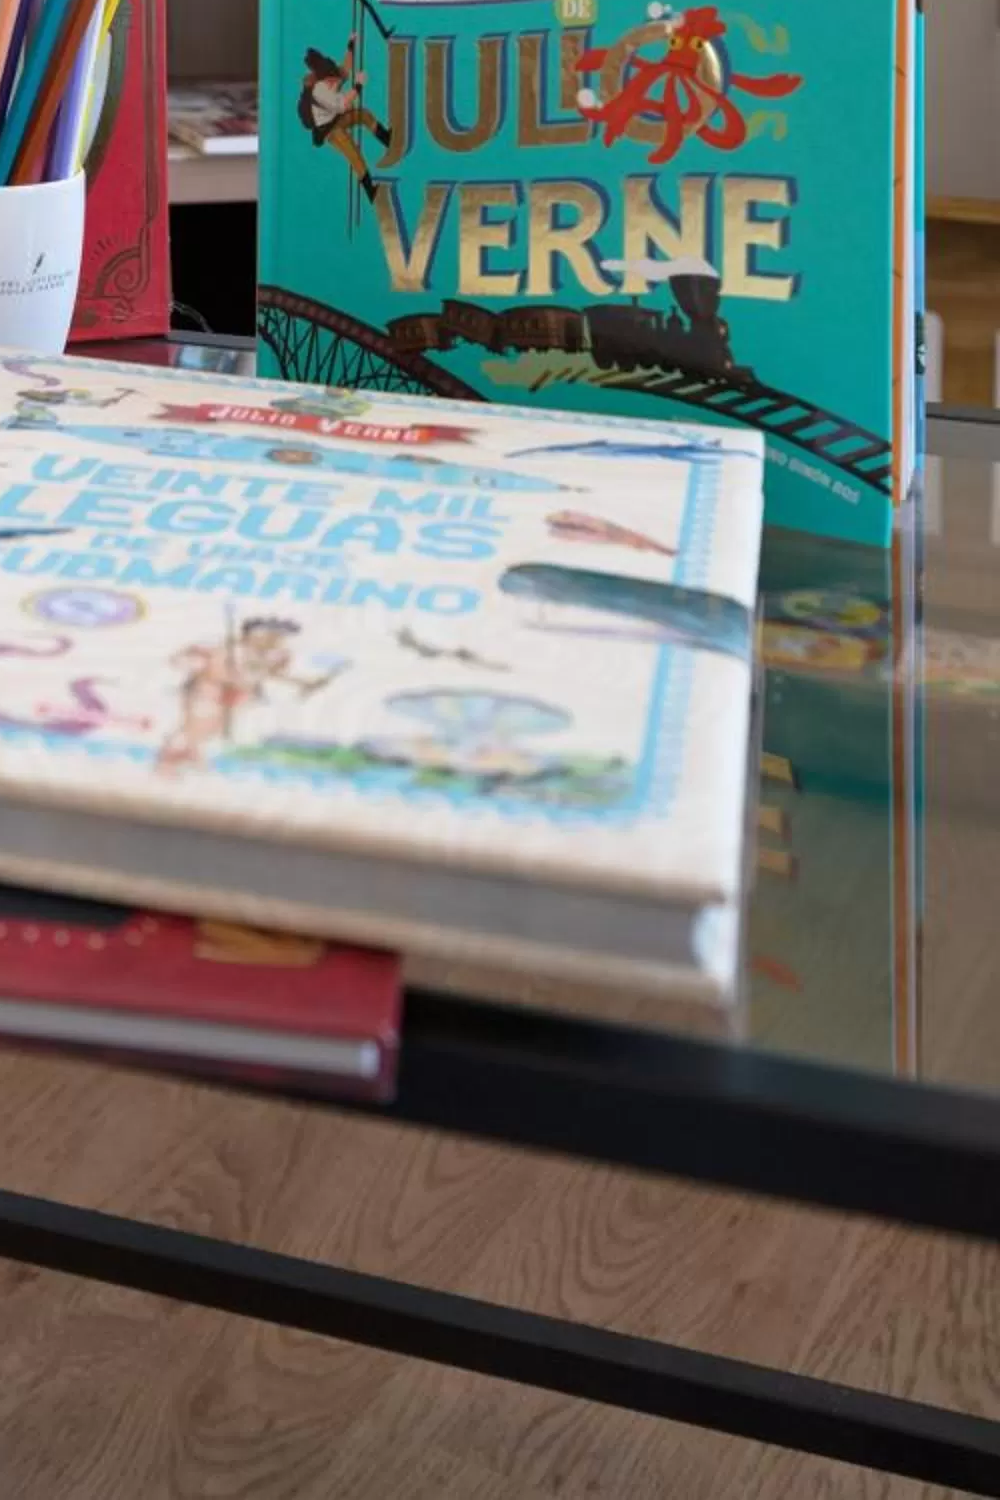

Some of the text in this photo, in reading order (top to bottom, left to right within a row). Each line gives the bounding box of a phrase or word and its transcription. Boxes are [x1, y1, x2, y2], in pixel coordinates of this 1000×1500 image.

[374, 20, 732, 169] JULIO
[371, 170, 800, 301] VERNE
[30, 453, 511, 524] VEINTE MIL
